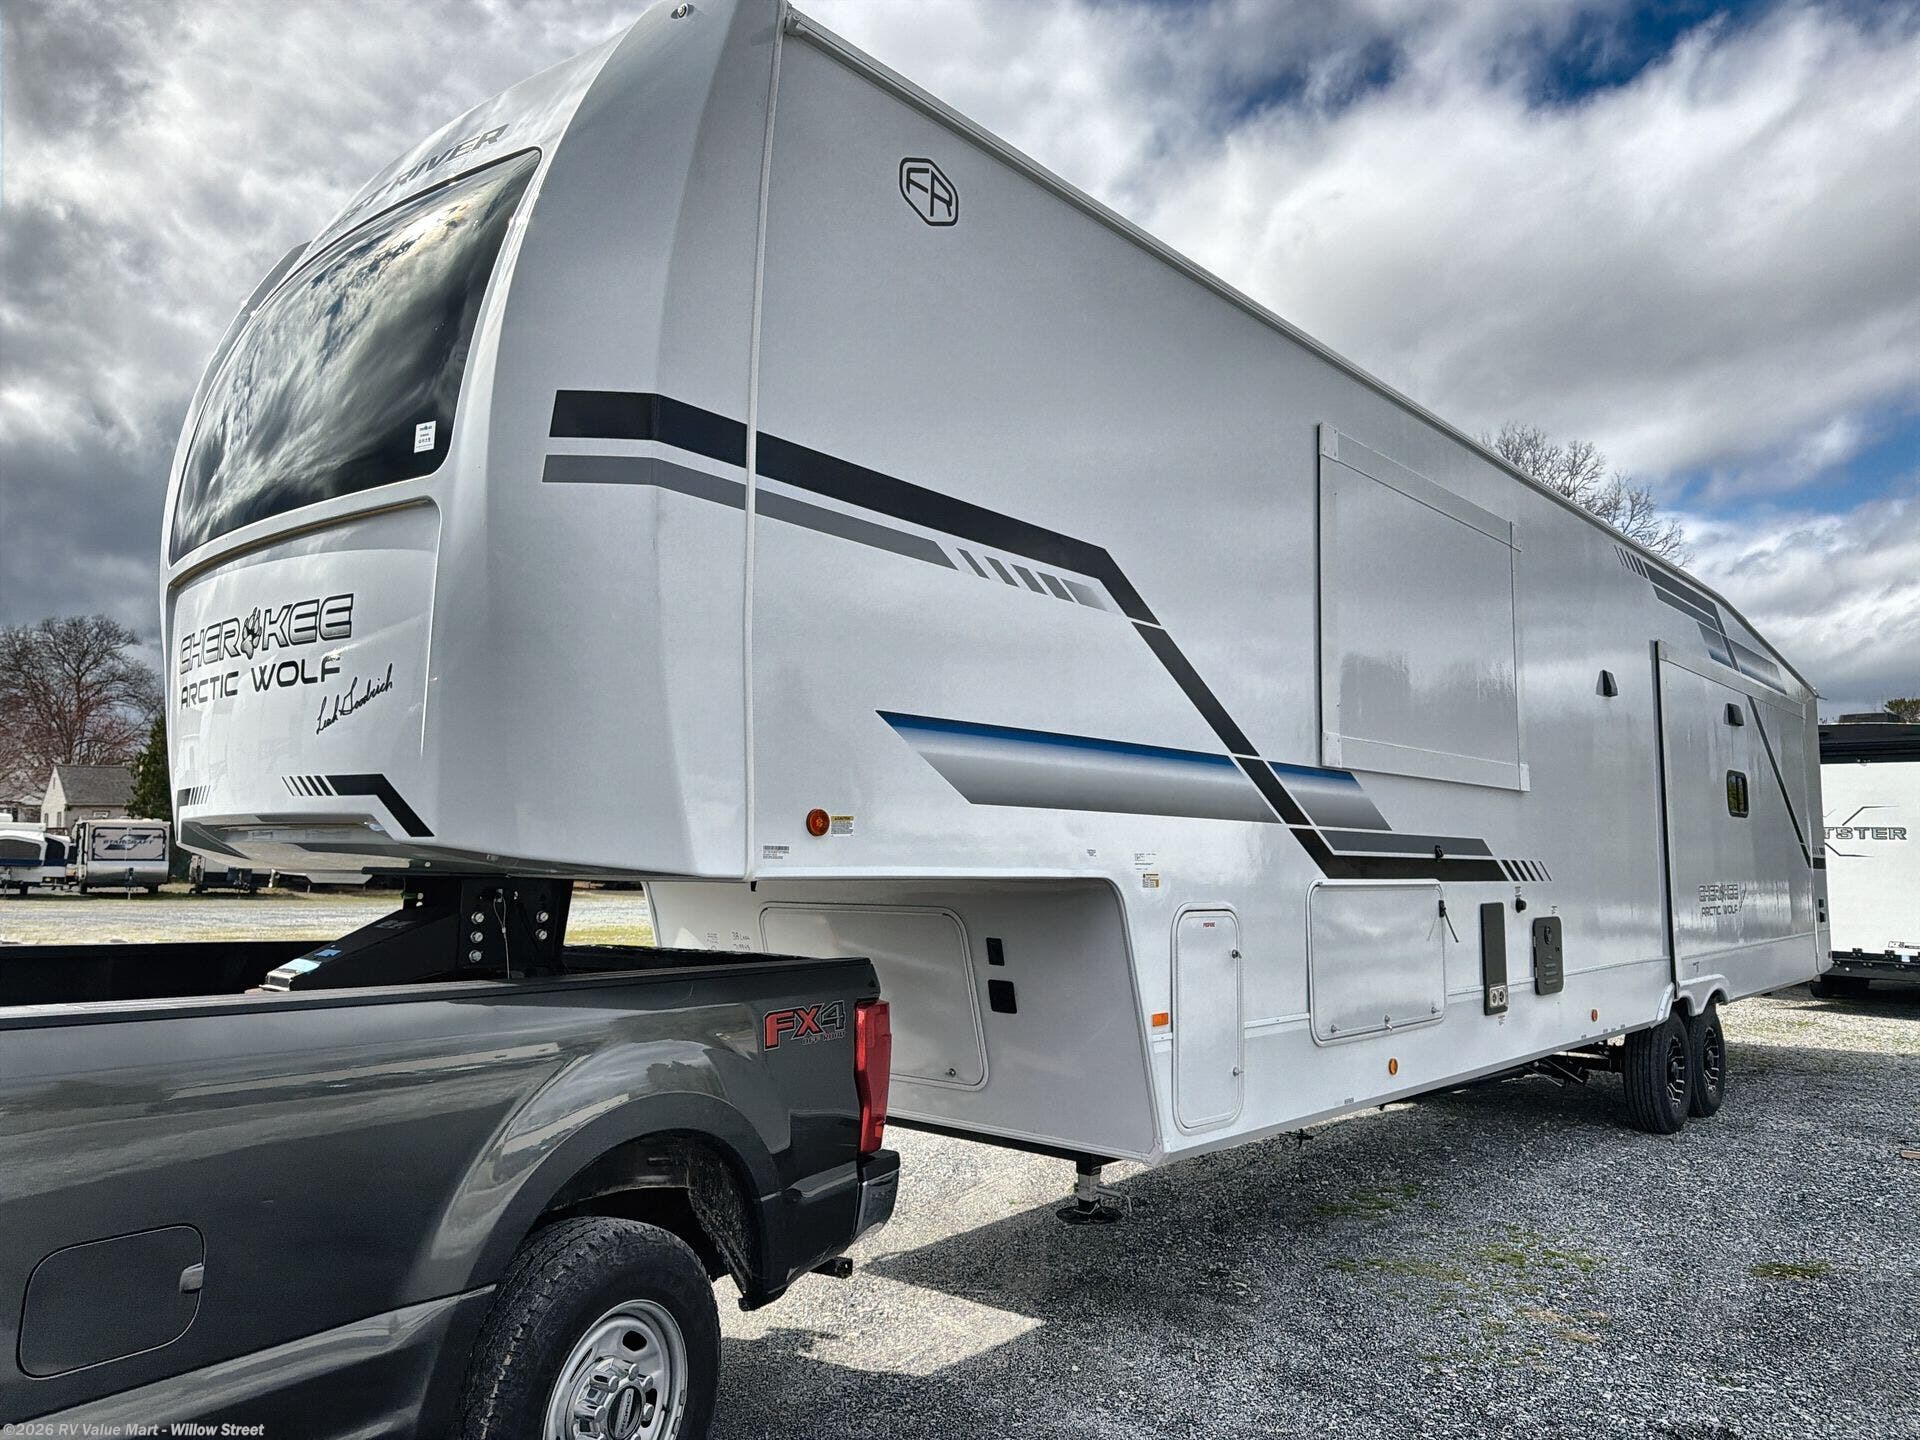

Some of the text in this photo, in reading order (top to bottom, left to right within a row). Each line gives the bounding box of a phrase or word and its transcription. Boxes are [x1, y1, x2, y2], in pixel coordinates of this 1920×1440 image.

[386, 124, 509, 194] RIVER
[181, 656, 341, 710] ARCTIC WOLF
[763, 1000, 846, 1052] FX4
